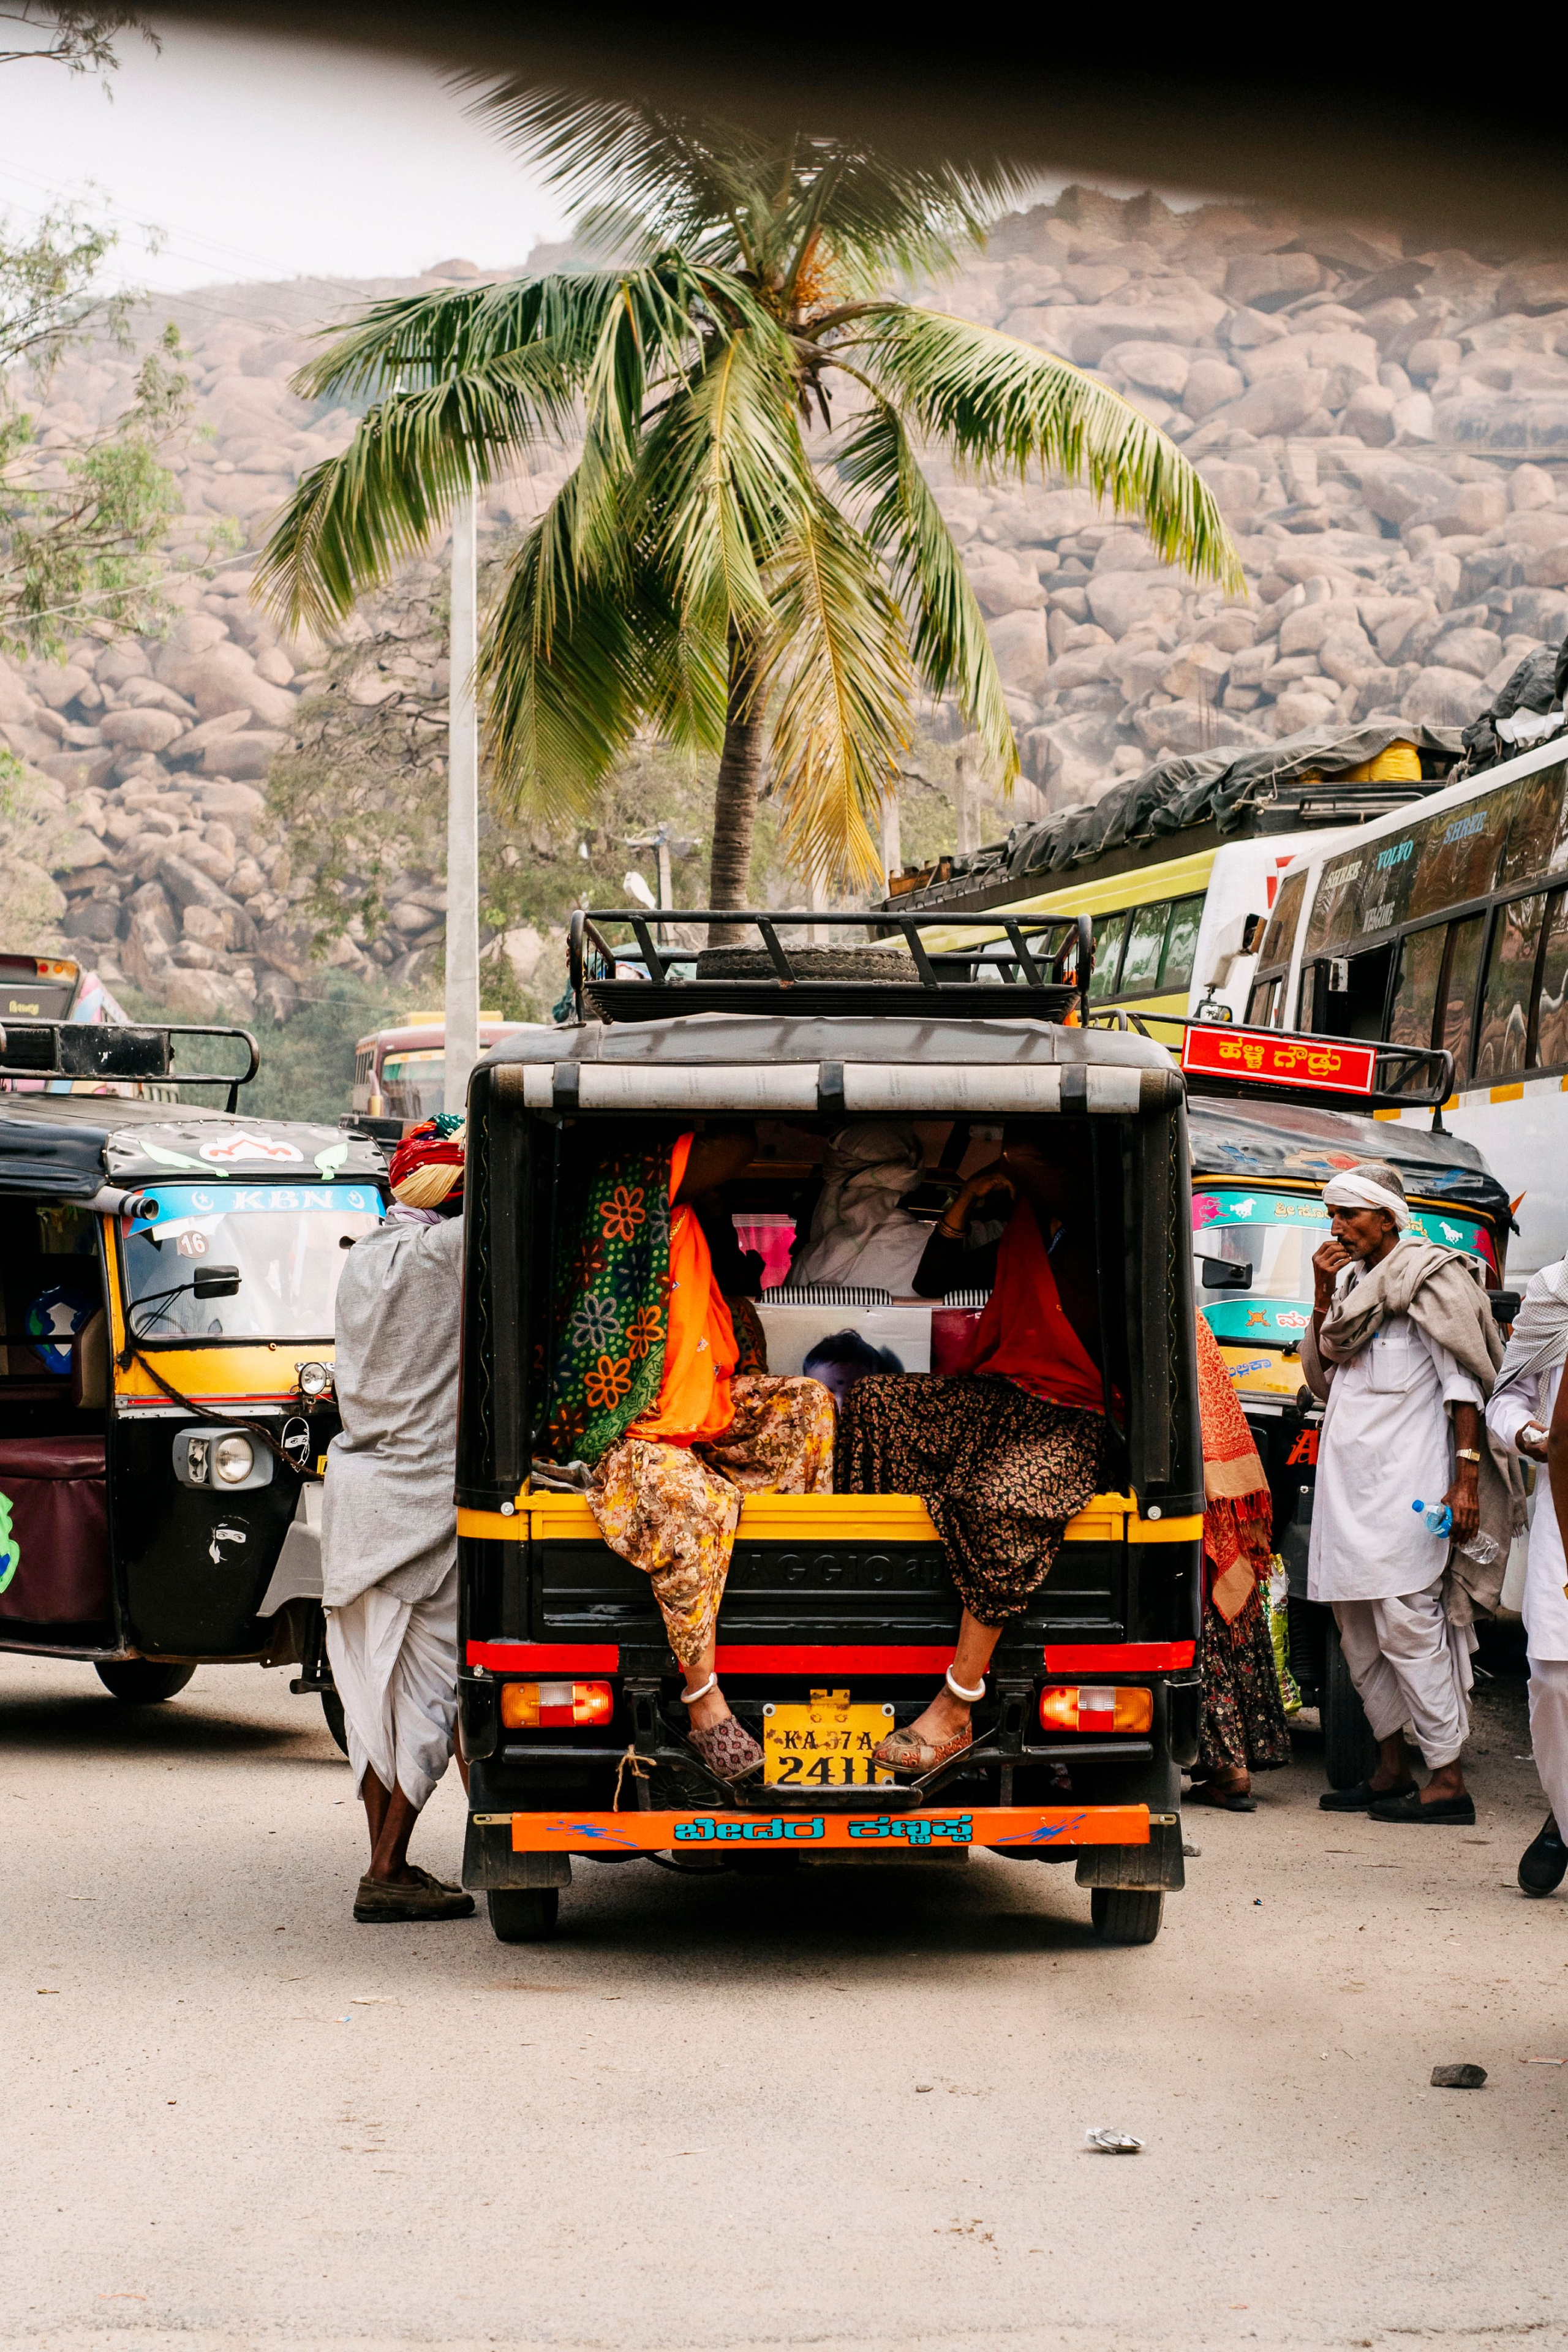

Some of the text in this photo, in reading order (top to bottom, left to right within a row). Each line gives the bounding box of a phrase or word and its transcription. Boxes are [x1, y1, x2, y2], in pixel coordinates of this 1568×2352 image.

[1377, 840, 1414, 871] VOLVO
[1219, 1037, 1341, 1077] ಹಳ್ಳಿ ಗೌಡ್ರು
[233, 1189, 334, 1210] KBN
[1274, 1202, 1295, 1218] ಶ್ರೀ
[181, 1233, 206, 1254] 16
[783, 1730, 818, 1749] KA
[858, 1732, 874, 1750] A
[777, 1756, 878, 1785] 2411
[674, 1814, 973, 1845] ಬೇಡರ ಕಣ್ಣಪ್ಪ
